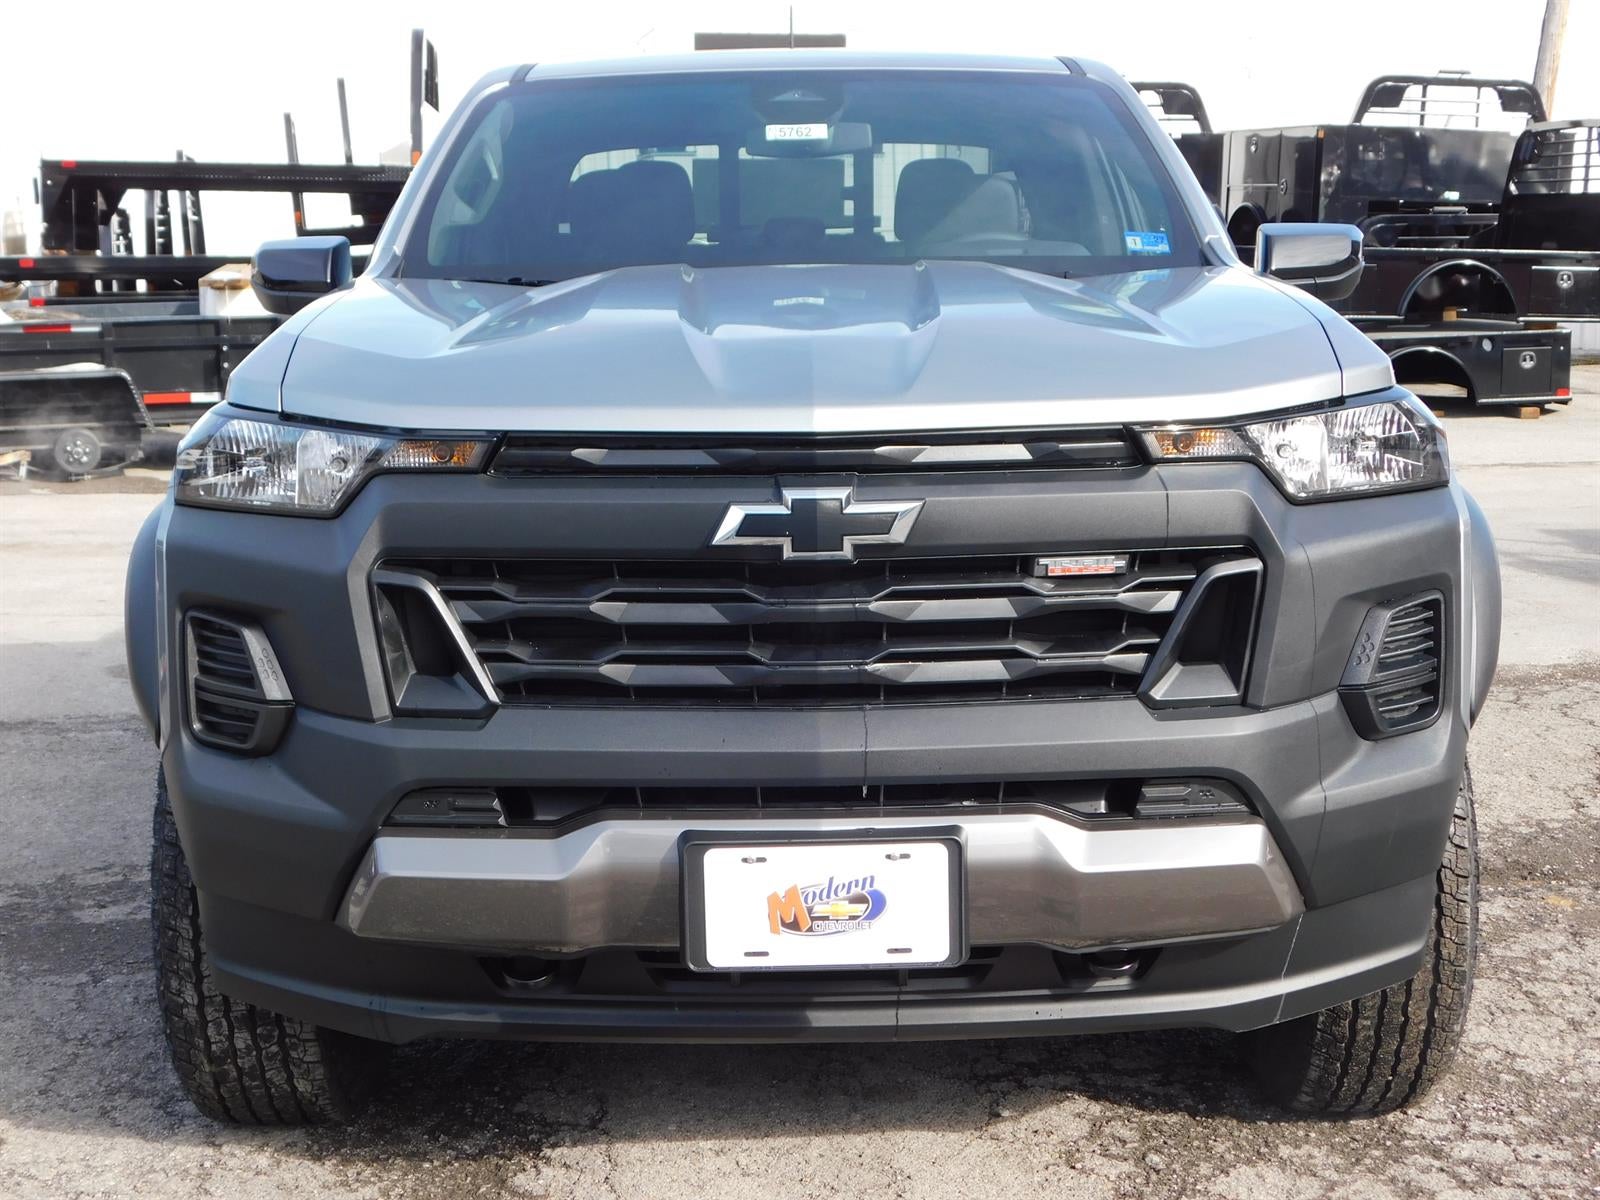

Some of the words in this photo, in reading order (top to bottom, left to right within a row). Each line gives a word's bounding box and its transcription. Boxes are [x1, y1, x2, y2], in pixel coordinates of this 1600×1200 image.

[779, 127, 812, 137] 5762
[767, 875, 875, 935] Modern
[812, 920, 873, 932] CHEVROLET
